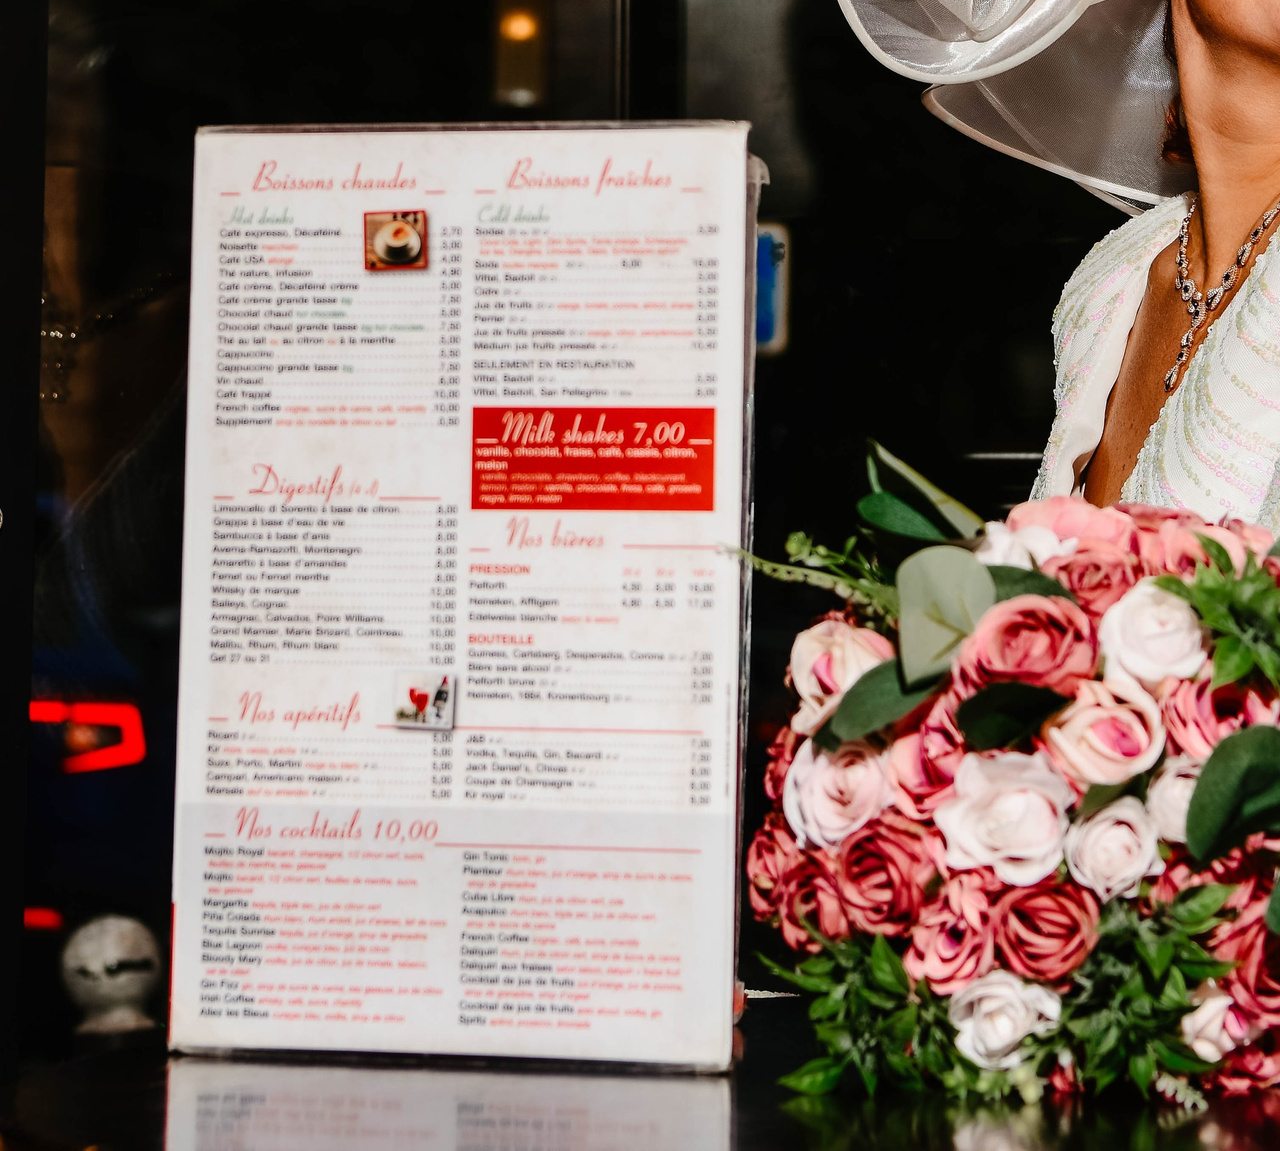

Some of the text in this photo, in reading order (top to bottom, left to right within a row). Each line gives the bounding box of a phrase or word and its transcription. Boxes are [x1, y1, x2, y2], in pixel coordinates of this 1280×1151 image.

[252, 160, 417, 192] Boissons chaudes
[506, 157, 672, 197] Boissons fraîches
[225, 206, 294, 225] Hot drinks
[478, 202, 551, 223] Cold drinks
[219, 243, 258, 252] Noisette
[502, 411, 686, 448] Milk shakes 7,00
[249, 462, 344, 502] Digestifs
[505, 515, 604, 549] Nos bières
[469, 563, 531, 576] PRESSION
[468, 633, 534, 646] BOUTEILLE
[238, 690, 361, 732] Nos apéritifs
[235, 805, 439, 844] Nos cocktails 10,00
